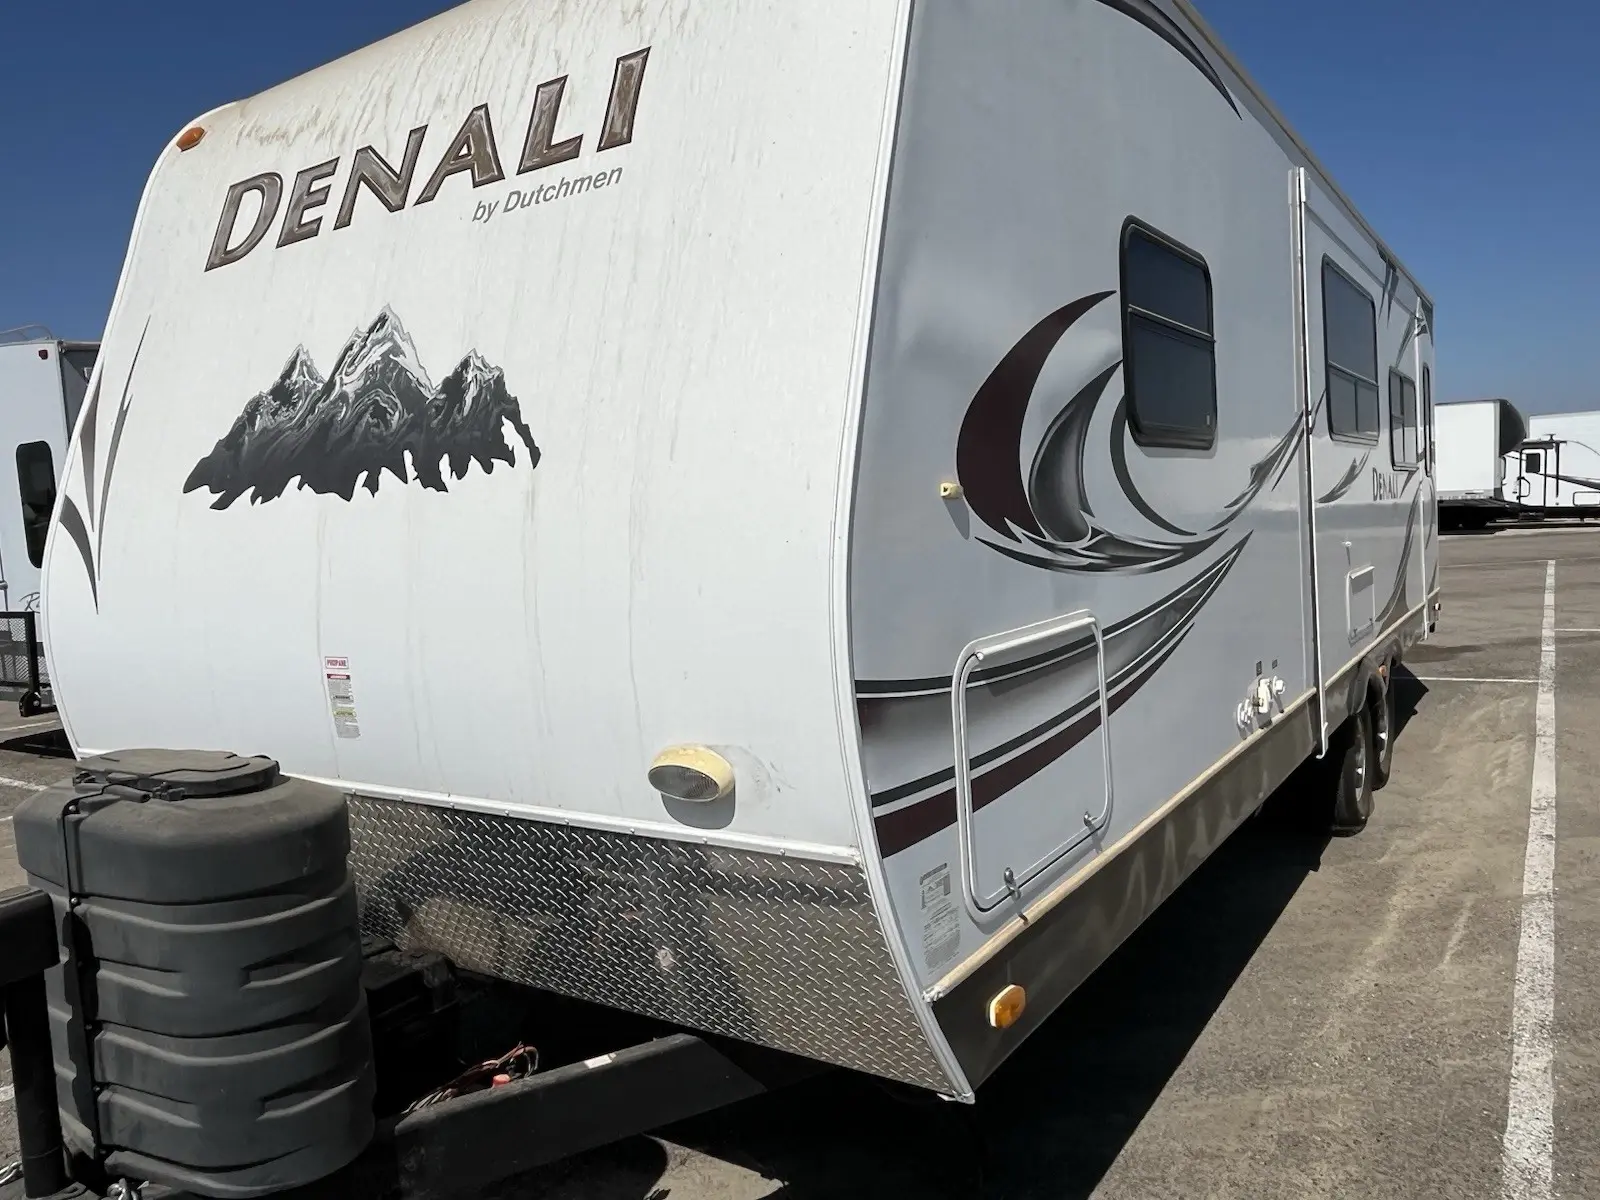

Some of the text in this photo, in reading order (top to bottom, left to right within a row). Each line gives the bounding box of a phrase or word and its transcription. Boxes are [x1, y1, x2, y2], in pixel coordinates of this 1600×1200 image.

[204, 46, 651, 272] DENALI
[472, 166, 623, 224] by Dutchmen
